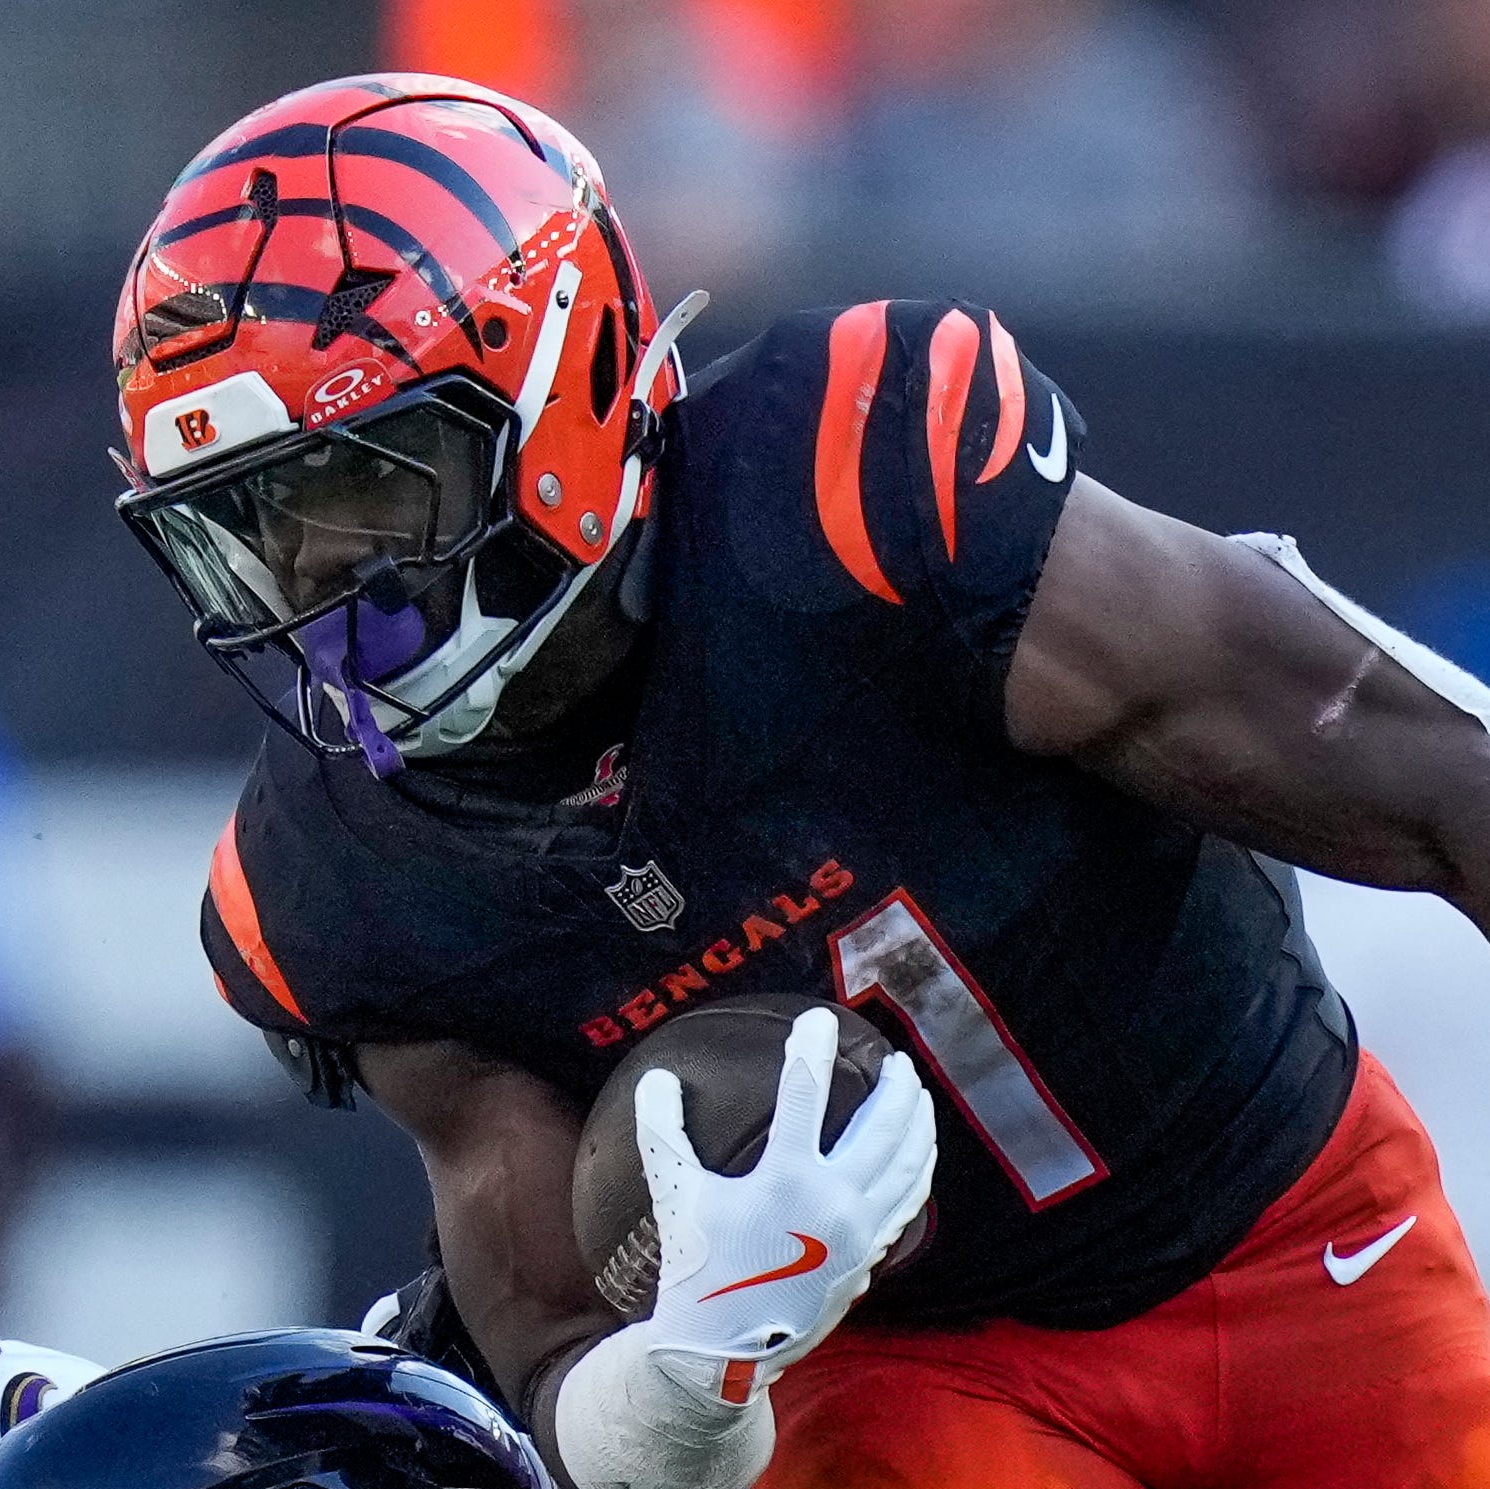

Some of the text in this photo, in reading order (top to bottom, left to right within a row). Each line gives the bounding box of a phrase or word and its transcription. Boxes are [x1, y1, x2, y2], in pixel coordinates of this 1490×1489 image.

[309, 373, 383, 425] OAKLEY
[579, 858, 856, 1048] BENGALS
[827, 886, 1110, 1213] 1
